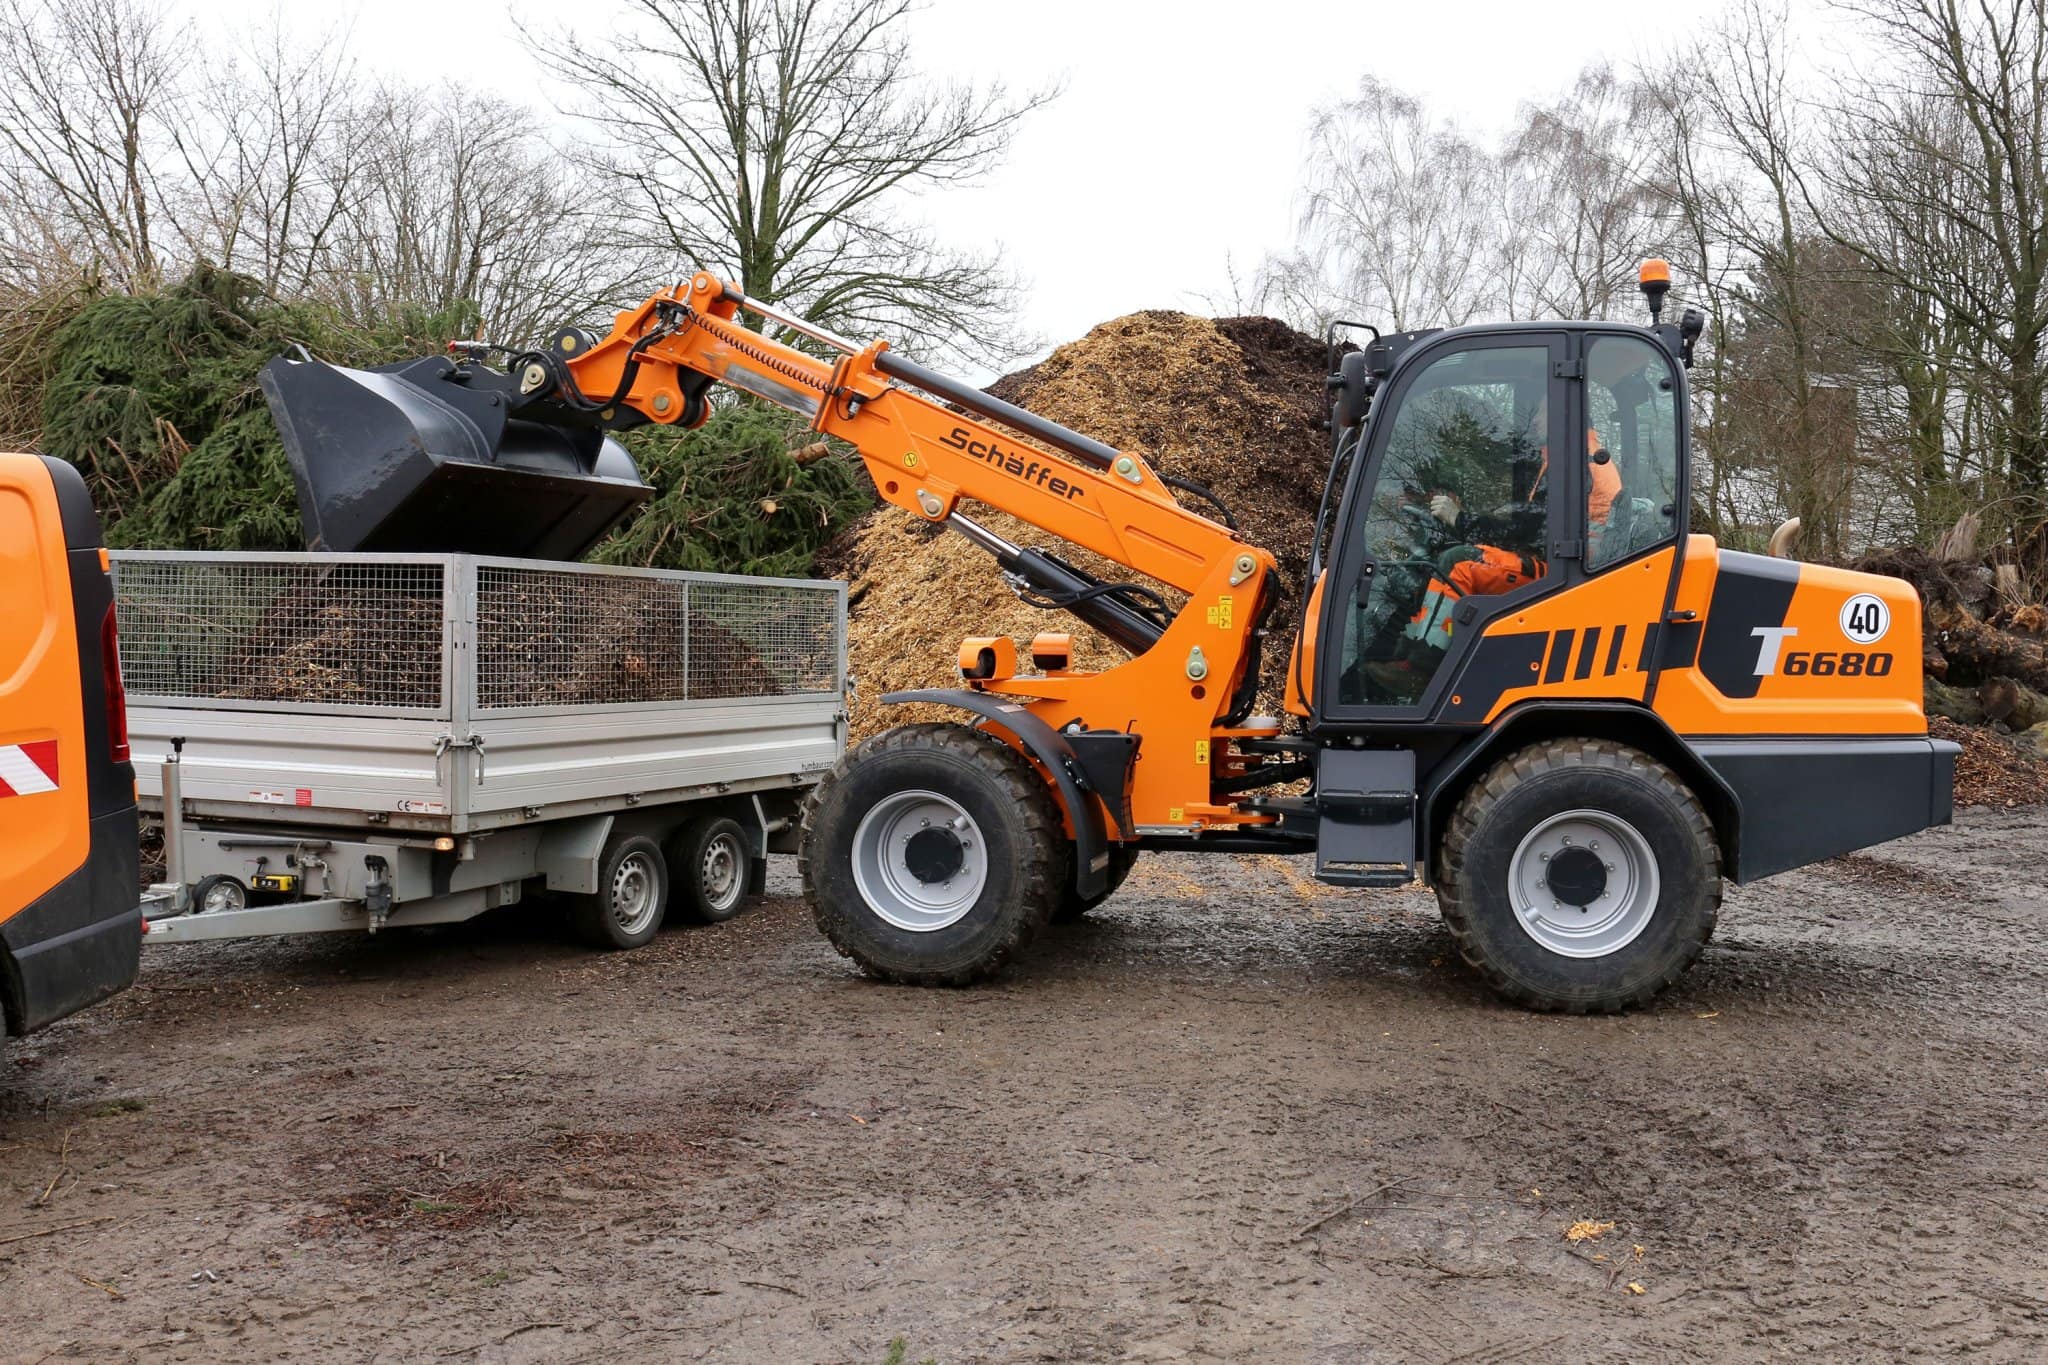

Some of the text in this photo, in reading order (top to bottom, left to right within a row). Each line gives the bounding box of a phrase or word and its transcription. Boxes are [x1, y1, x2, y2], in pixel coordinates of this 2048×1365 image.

[939, 427, 1085, 500] Schäffer
[1848, 603, 1880, 635] 40
[1783, 652, 1893, 676] 6680
